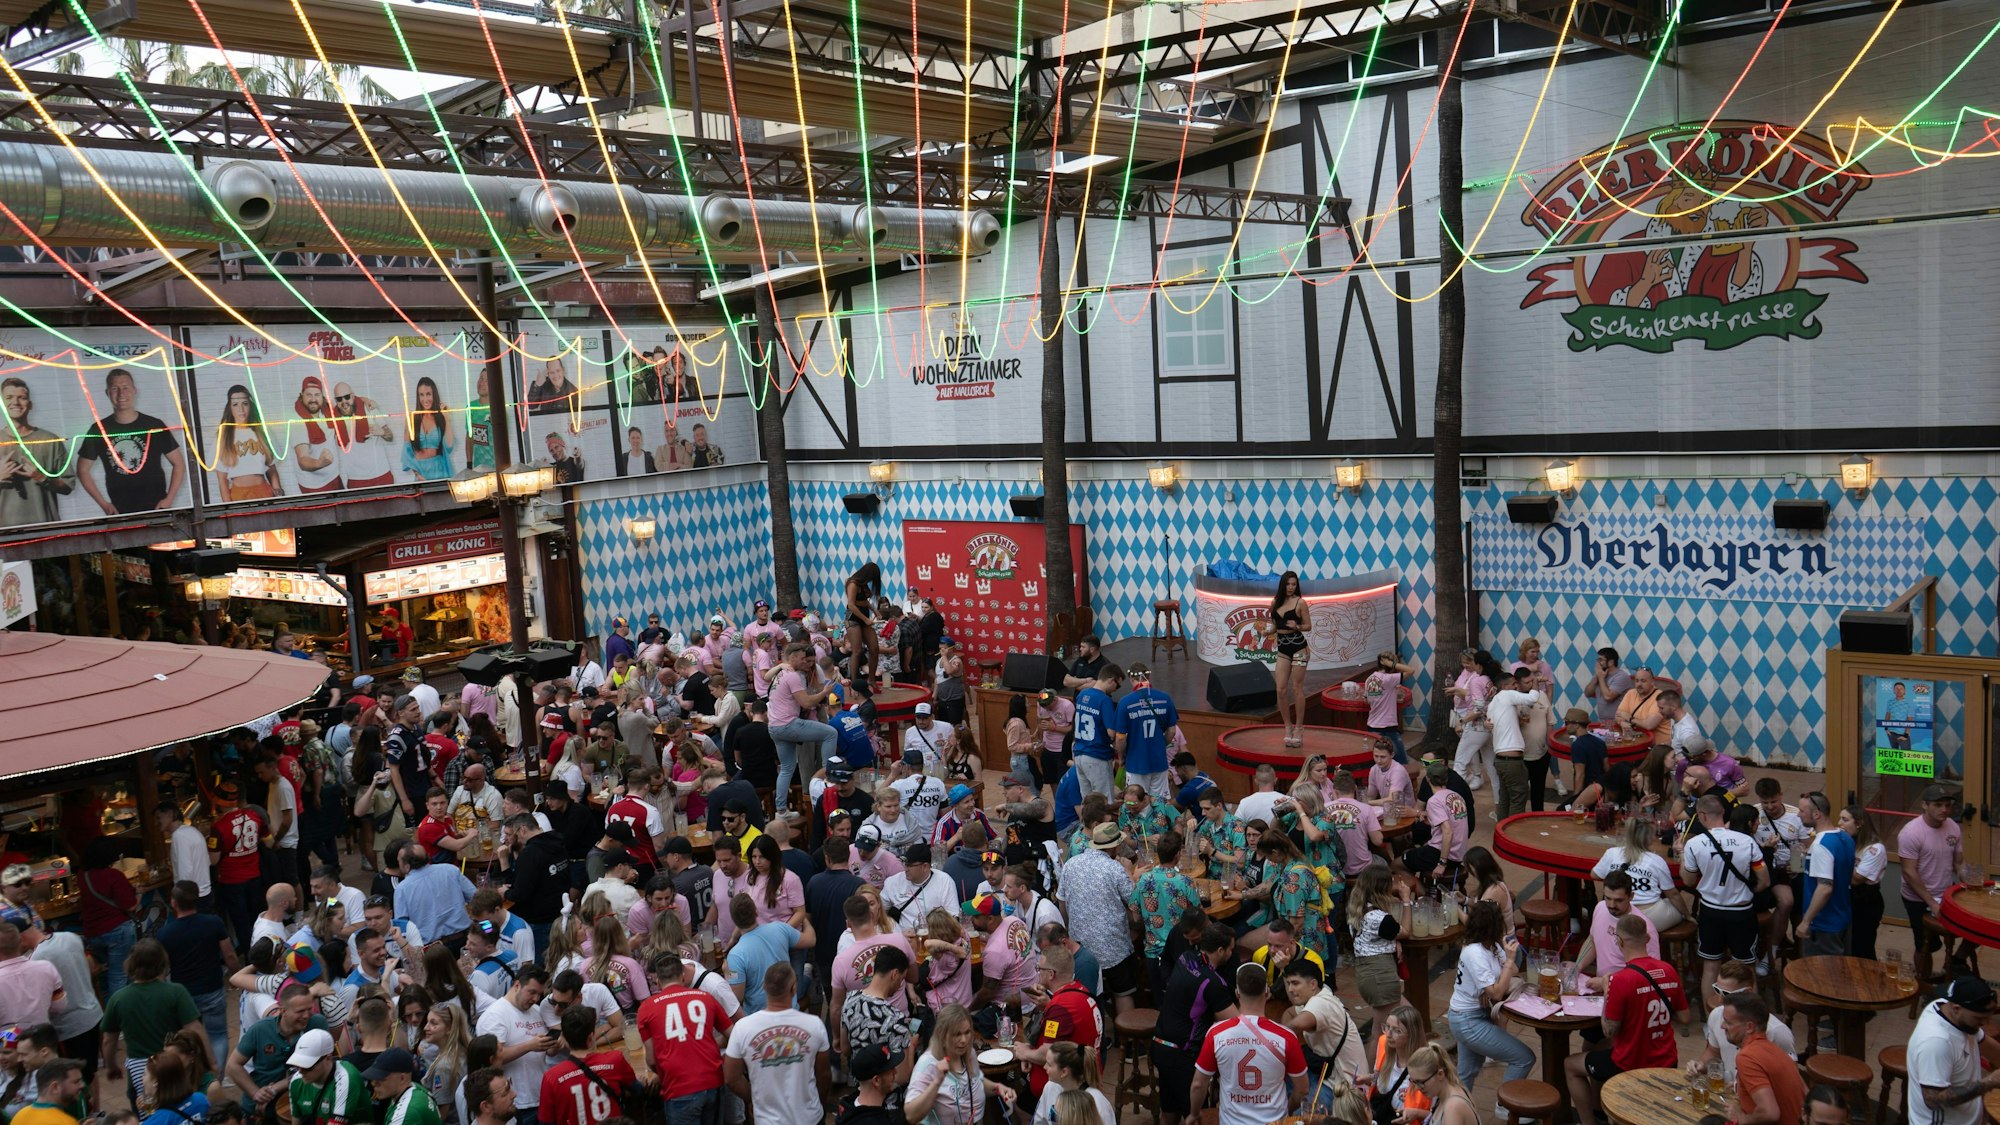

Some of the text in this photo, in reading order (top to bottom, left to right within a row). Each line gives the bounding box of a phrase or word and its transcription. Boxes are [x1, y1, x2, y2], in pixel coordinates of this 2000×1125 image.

[1537, 130, 1850, 234] BIERKÖNIG
[945, 335, 982, 357] DEIN
[912, 358, 1022, 386] WOHNZIMMER
[464, 524, 483, 532] Snack
[395, 537, 486, 558] GRILL KÖNIG
[967, 535, 1018, 554] BIERKÖNIG
[1537, 522, 1837, 592] Oberbayern
[1074, 711, 1096, 742] 13
[1142, 719, 1156, 739] 17
[1878, 750, 1903, 758] HEUTE
[1905, 763, 1932, 774] LIVE!
[1711, 851, 1733, 887] 7
[666, 1000, 707, 1042] 49
[1226, 1038, 1250, 1046] BAYERN
[1237, 1049, 1262, 1091] 6
[570, 1079, 612, 1125] 18
[1230, 1093, 1272, 1104] KIMMICH
